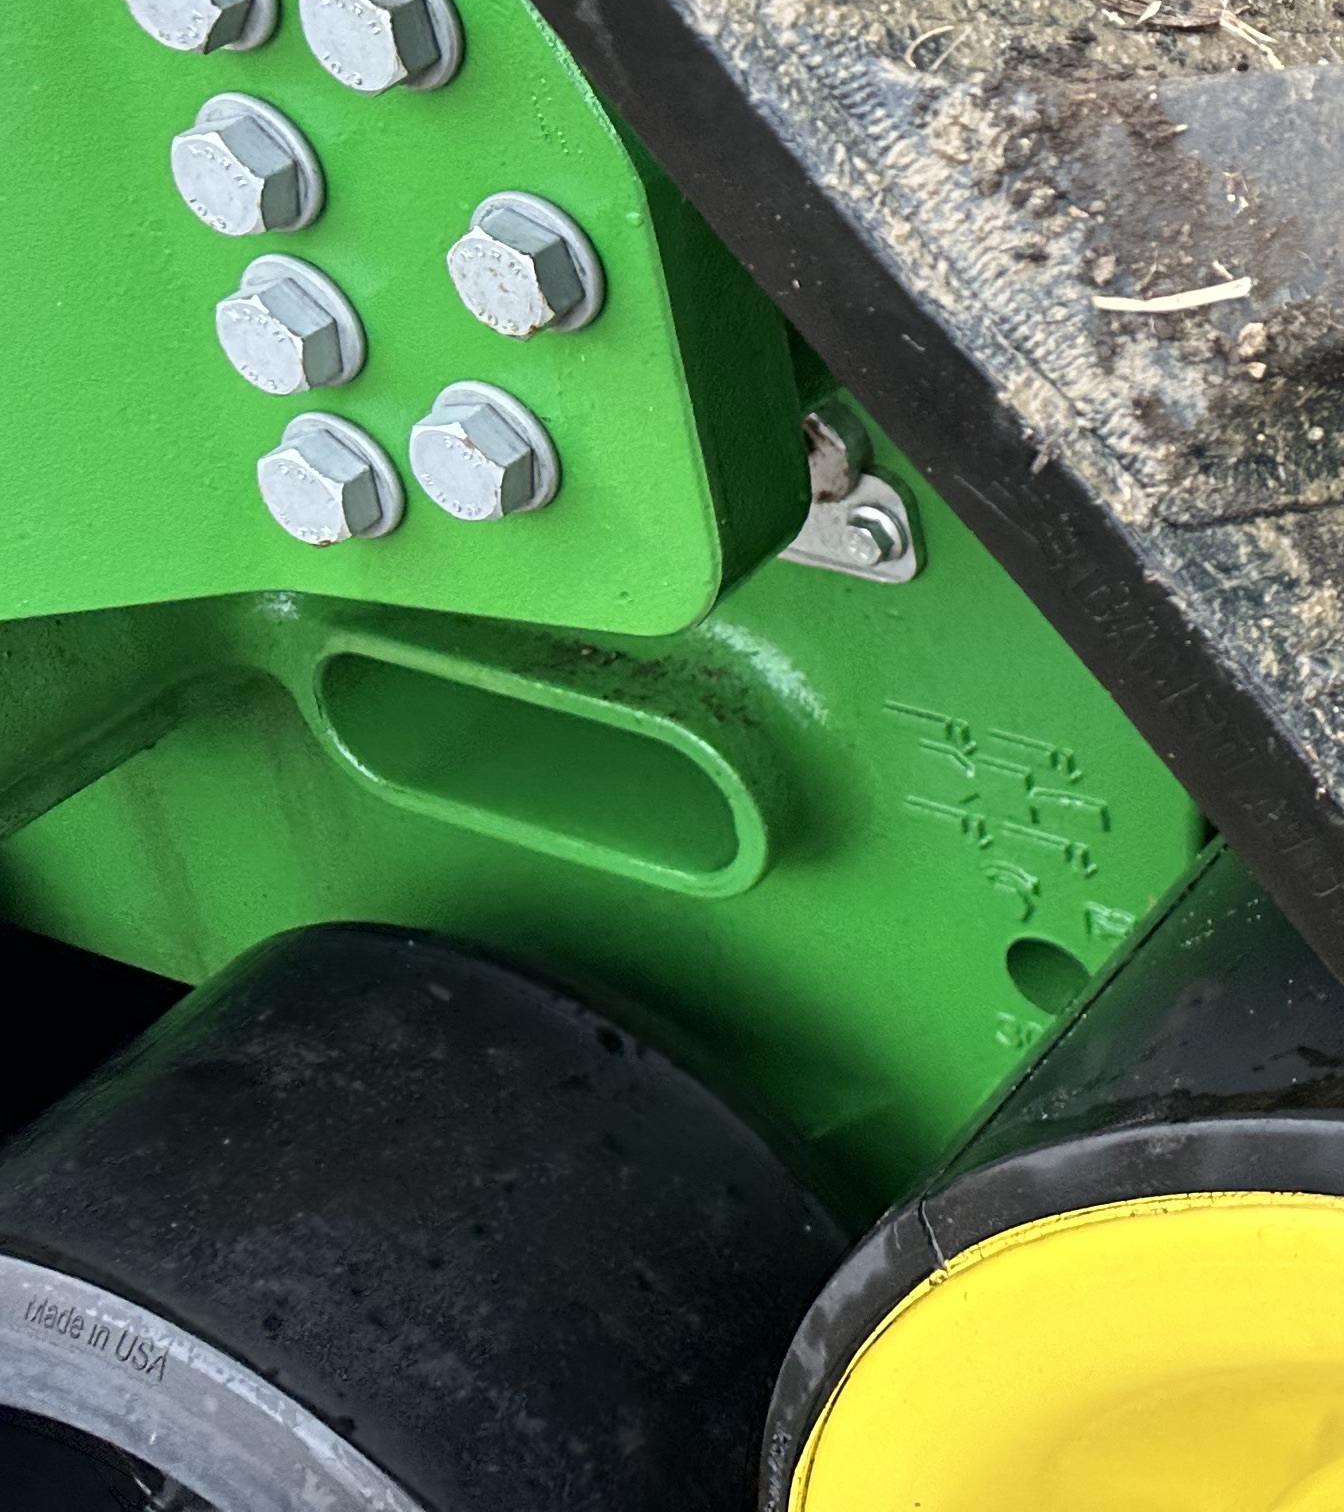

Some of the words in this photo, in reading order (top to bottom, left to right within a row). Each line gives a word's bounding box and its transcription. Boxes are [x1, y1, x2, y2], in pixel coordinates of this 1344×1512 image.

[24, 1294, 85, 1339] Made
[87, 1324, 111, 1351] in
[114, 1329, 170, 1383] USA
